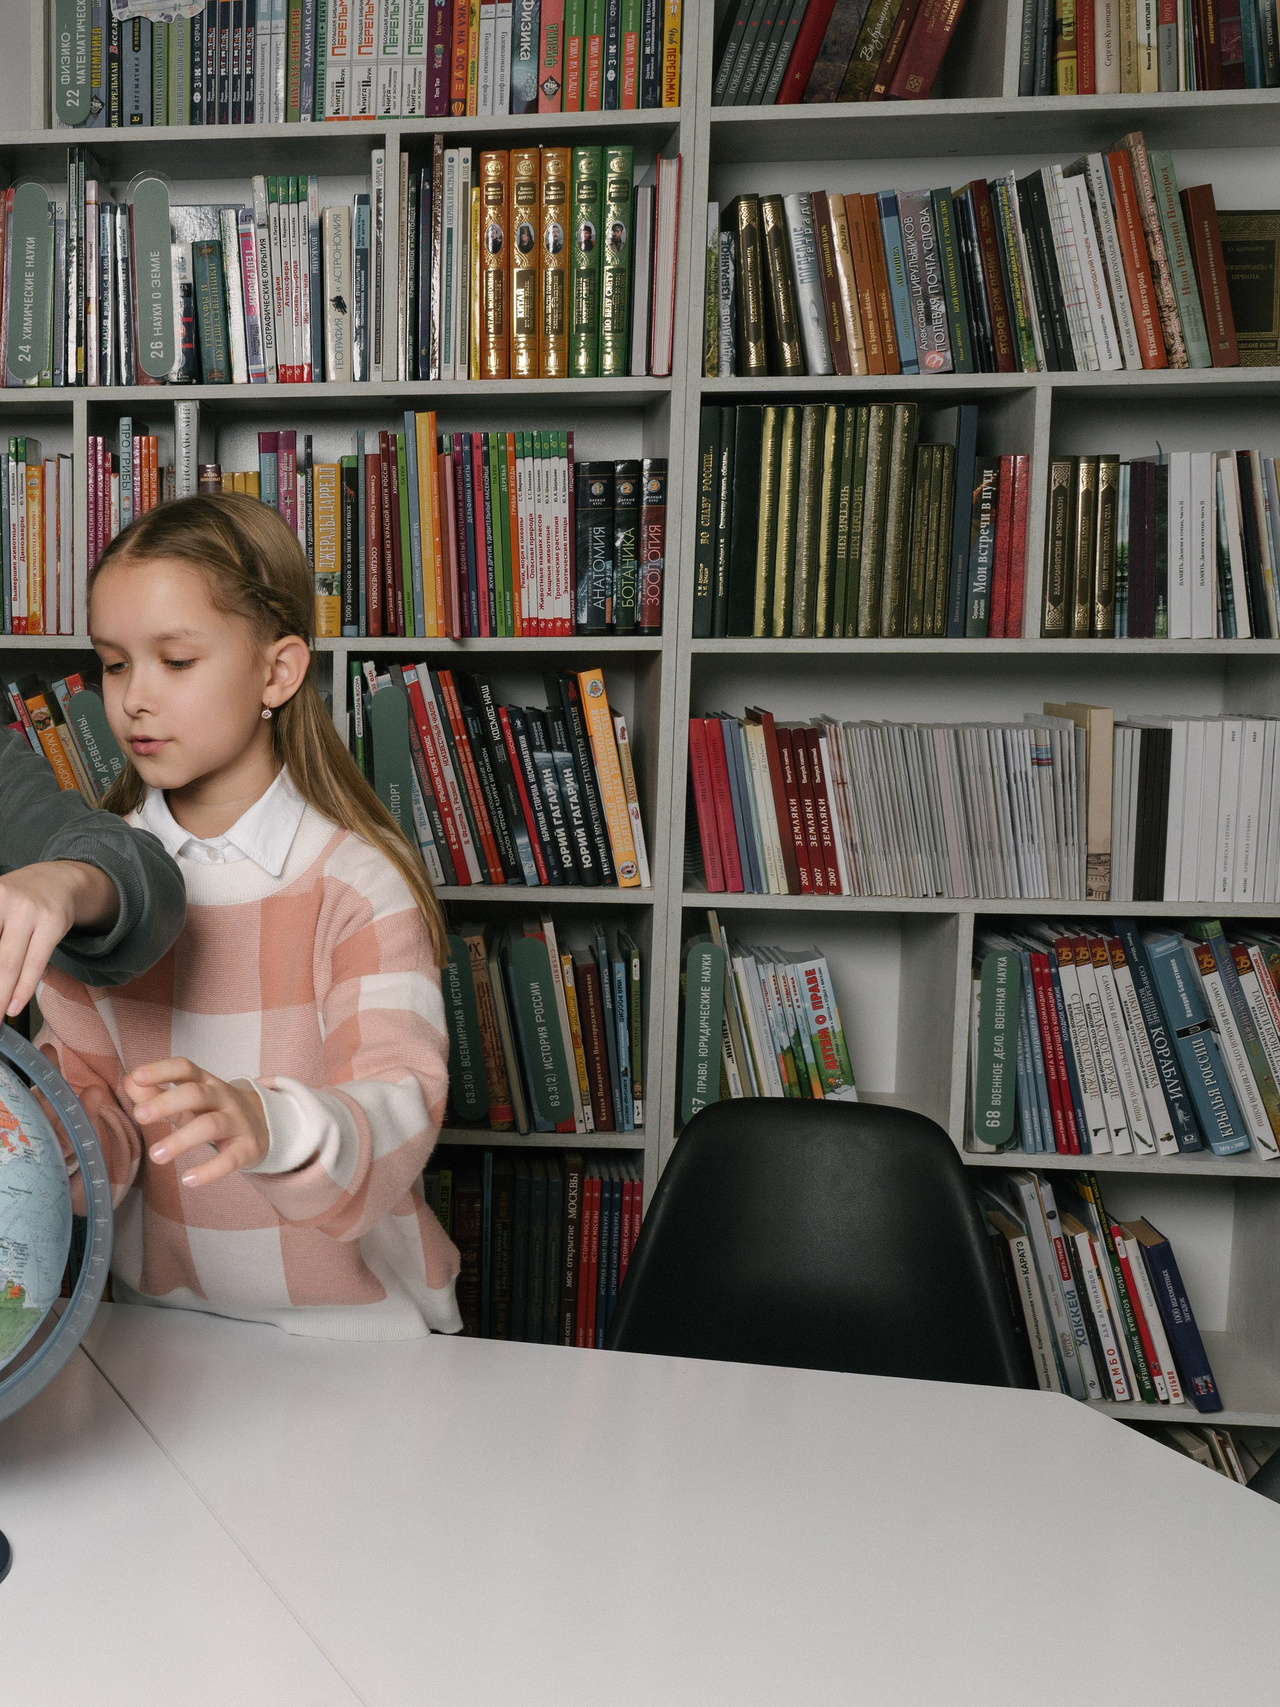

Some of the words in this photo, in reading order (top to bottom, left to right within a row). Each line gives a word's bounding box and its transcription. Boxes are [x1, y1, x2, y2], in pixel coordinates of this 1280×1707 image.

[76, 0, 87, 85] МАТЕМАТИЧЕСК
[290, 9, 301, 62] ВЕСЕЛЫЕ
[520, 0, 536, 61] Физика
[1104, 2, 1112, 40] Кузнецов
[61, 32, 71, 85] ФИЗИКО
[91, 26, 102, 88] МАТЕМАТИКА
[665, 47, 677, 103] ПЕРЕЛЬМАН
[715, 42, 737, 94] ПОБЕДИТЕЛИ
[729, 42, 750, 94] ПОБЕДИТЕЛИ
[742, 42, 765, 94] ПОБЕДИТЕЛИ
[755, 42, 777, 94] ПОБЕДИТЕЛИ
[768, 42, 790, 94] ПОБЕДИТЕЛИ
[1104, 40, 1112, 67] Сергей
[66, 89, 80, 107] 22
[290, 65, 300, 108] ЗАДАЧИ
[1160, 165, 1178, 220] Новгород
[332, 213, 343, 284] АСТРОНОМИЯ
[798, 195, 816, 264] тетради
[919, 206, 937, 252] СЛОВА
[1083, 236, 1094, 259] ПОЧЕРК
[1169, 221, 1187, 269] Нижний
[25, 237, 35, 268] НАУКИ
[150, 251, 160, 288] ЗЕМЛЕ
[260, 238, 270, 279] ОТКРЫТИЯ
[310, 237, 318, 274] ВУЛКАНЫ
[720, 239, 731, 300] ИЗБРАННОЕ
[902, 215, 924, 297] ЦИРУЛЬНИКОВ
[924, 253, 942, 294] ПОЧТА
[201, 284, 208, 292] И
[245, 249, 257, 306] ГЕОГРАФИЯ
[282, 261, 290, 307] Атмосфера
[985, 249, 1005, 312] РОЖДЕНИЕ
[1088, 259, 1104, 310] НИЖЕГОРОДСКИЙ
[1135, 271, 1154, 317] Новгород
[1179, 268, 1192, 297] Наш
[23, 272, 34, 341] ХИМИЧЕСКИЕ
[151, 303, 163, 336] НАУКИ
[203, 296, 213, 347] ГЕОГРАФЫ
[209, 263, 223, 361] ПУТЕШЕСТВЕННИКИ
[262, 280, 273, 349] ГЕОГРАФИЧЕСКИЕ
[516, 288, 525, 319] КИТАЙ
[914, 298, 929, 351] Александр
[929, 296, 949, 353] ПОЛЕВАЯ
[18, 344, 32, 361] 24
[150, 341, 164, 359] 26
[334, 318, 344, 371] ГЕОГРАФИЯ
[993, 314, 1010, 355] ВТОРОЕ
[1142, 317, 1159, 357] Нижний
[181, 404, 190, 430] МИР
[181, 432, 191, 483] ПОЗНАЮ
[319, 466, 336, 513] ДАРРЕЛЛ
[980, 468, 995, 501] пути
[980, 502, 992, 511] в
[10, 522, 18, 561] животные
[18, 515, 26, 563] Динозавры
[318, 513, 336, 569] ДЖЕРАЛЬД
[561, 516, 569, 547] птицы
[974, 512, 991, 564] встречи
[371, 546, 379, 571] СОСЕДИ
[554, 552, 562, 601] Тропические
[562, 548, 570, 595] Экзотические
[592, 525, 606, 610] АНАТОМИЯ
[621, 526, 636, 608] БОТАНИКА
[647, 524, 662, 607] ЗООЛОГИЯ
[971, 566, 989, 595] Мои
[10, 562, 18, 602] Вымершие
[371, 573, 379, 610] ЧЕЛОВЕКА
[538, 567, 546, 611] Животные
[545, 567, 553, 597] Хищные
[480, 684, 493, 705] НАШ
[76, 714, 108, 773] ДРЕВЕСИНЫ.
[486, 704, 502, 741] КОСМОС
[570, 706, 583, 736] ЗЕМЛЯ
[599, 706, 619, 775] РЕЗИНОЧЕК
[519, 734, 537, 783] КОСМОНАВТИКИ
[576, 738, 593, 783] ПЛАНЕТЫ
[590, 707, 613, 798] ЭНЦИКЛОПЕДИЯ
[784, 765, 792, 784] Выпуск
[531, 783, 544, 811] СТОРОНА
[542, 767, 563, 825] ГАГАРИН
[562, 767, 583, 825] ГАГАРИН
[585, 783, 604, 836] КОСМОНАВТ
[612, 777, 634, 851] ВОЛШЕБНЫХ
[536, 811, 551, 842] ОБРАТНАЯ
[610, 800, 624, 854] БОЛЬШАЯ
[789, 798, 803, 847] ЗЕМЛЯКИ
[556, 827, 574, 869] ЮРИЙ
[576, 827, 594, 869] ЮРИЙ
[598, 835, 612, 876] ПЕРВЫЙ
[799, 867, 809, 886] 2007
[447, 962, 463, 1007] ИСТОРИЯ
[701, 953, 712, 983] НАУКИ
[804, 967, 824, 1011] ПРАВЕ
[995, 955, 1008, 985] НАУКА
[529, 981, 547, 1023] РОССИИ
[698, 986, 712, 1057] ЮРИДИЧЕСКИЕ
[815, 1014, 827, 1025] О
[994, 987, 1007, 1030] ВОЕННАЯ
[453, 1008, 472, 1068] ВСЕМИРНАЯ
[536, 1026, 554, 1071] ИСТОРИЯ
[819, 1026, 839, 1071] ДЕТЯМ
[992, 1032, 1006, 1061] ДЕЛО.
[1068, 992, 1091, 1059] СТРЕЛКОВОЕ
[1082, 1058, 1100, 1101] ОРУЖИЕ
[1088, 992, 1112, 1059] СТРЕЛКОВОЕ
[1103, 1058, 1120, 1101] ОРУЖИЕ
[1209, 981, 1226, 1018] САМОЛЕТЫ
[1221, 1018, 1237, 1048] ВЕЛИКОЙ
[1231, 1048, 1256, 1104] ОТЕЧЕСТВЕННОЙ
[1249, 1104, 1265, 1128] ВОЙНЫ
[696, 1060, 708, 1093] ПРАВО.
[1150, 1025, 1184, 1101] КОРАБЛИ
[1191, 1037, 1218, 1085] РОССИИ
[463, 1070, 477, 1105] 63.3(0)
[543, 1072, 561, 1108] 63.3(2)
[990, 1062, 1003, 1107] ВОЕННОЕ
[985, 1109, 1002, 1128] 68
[1207, 1087, 1234, 1138] КРЫЛЬЯ
[567, 1172, 579, 1219] МОСКВЫ
[565, 1224, 576, 1268] открытие
[1015, 1240, 1031, 1276] КАРАТЭ
[565, 1270, 573, 1288] мое
[1087, 1268, 1105, 1319] НАЧИНАЮЩИХ
[1161, 1269, 1179, 1307] шахматных
[1066, 1288, 1088, 1348] ХОККЕЙ
[1100, 1322, 1110, 1339] ДЛЯ
[1171, 1307, 1183, 1324] 1000
[1106, 1347, 1126, 1395] САМБО
[1166, 1370, 1181, 1399] ФУТБОЛ
